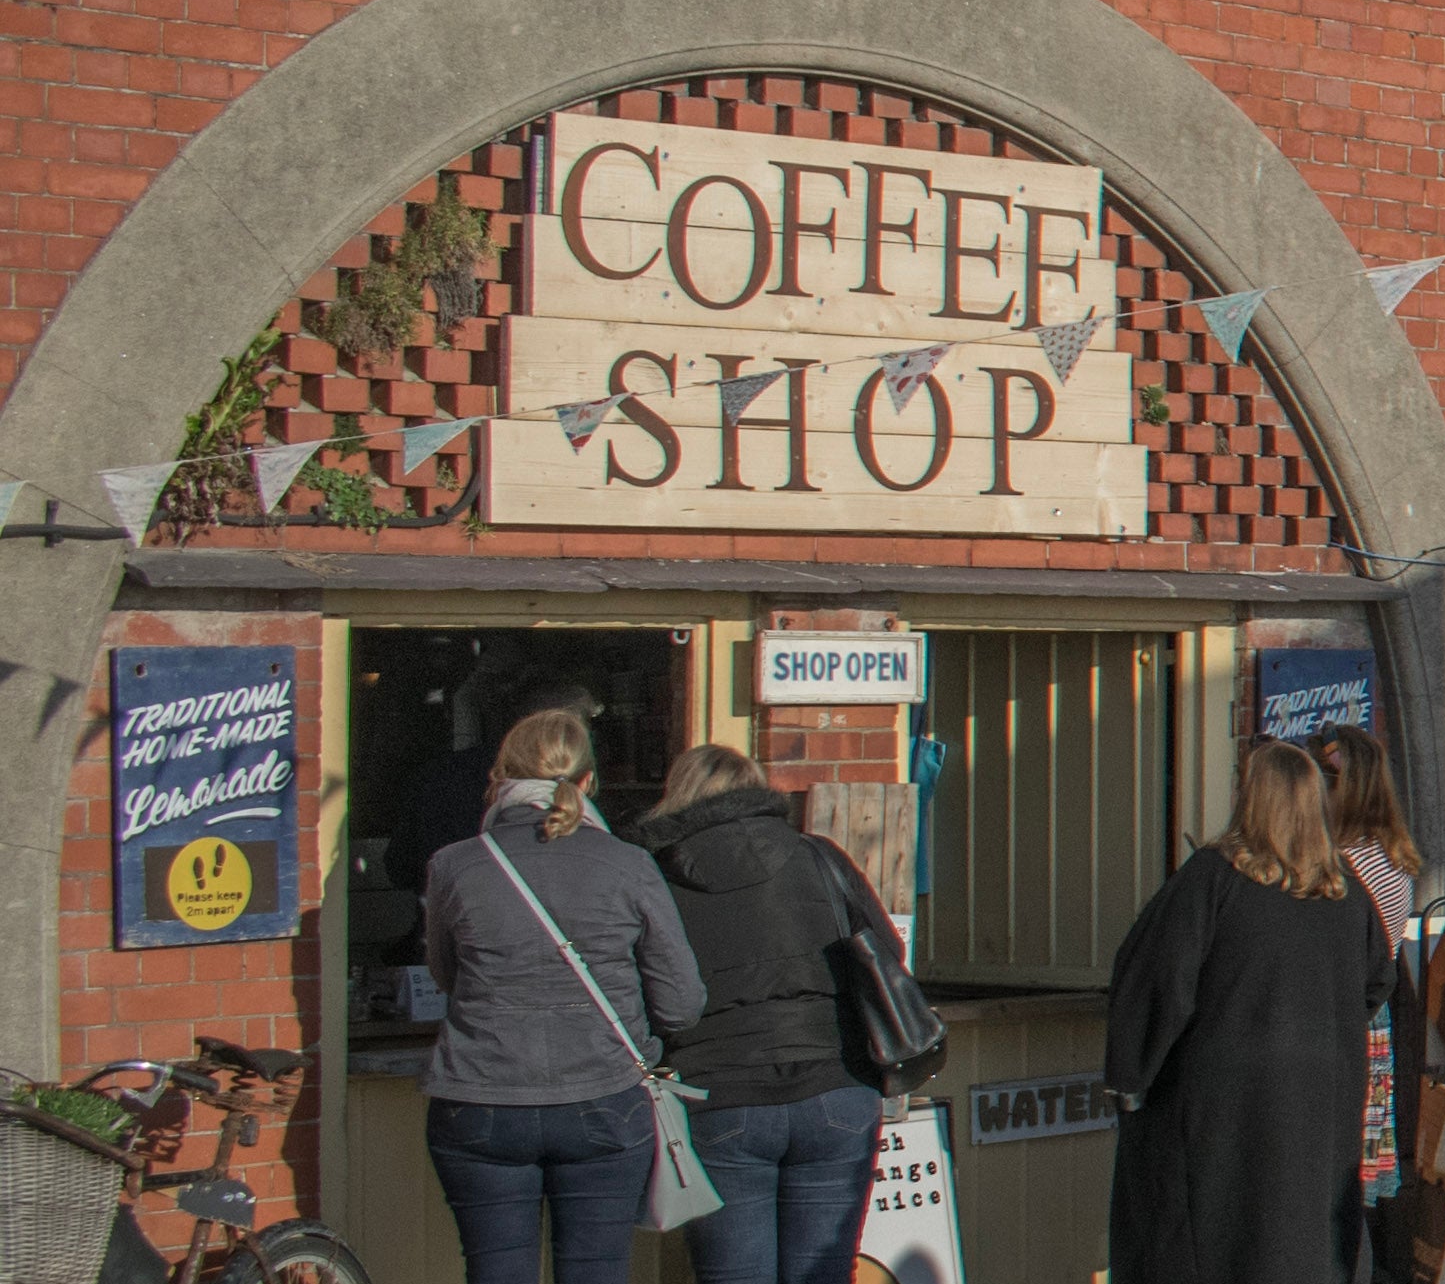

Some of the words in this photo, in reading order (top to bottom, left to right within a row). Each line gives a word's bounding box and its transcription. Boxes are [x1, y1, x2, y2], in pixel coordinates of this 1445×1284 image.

[560, 141, 1097, 333] COFFEE
[605, 348, 1058, 498] SHOP
[773, 652, 841, 682] SHOP
[846, 652, 908, 682] OPEN
[122, 679, 293, 739] TRADITIONAL
[1263, 677, 1370, 718] TRADITIONAL
[121, 709, 294, 770] HOME-MADE
[120, 748, 295, 843] Lemonade
[177, 892, 215, 905] Please
[216, 890, 244, 904] keep
[186, 905, 205, 917] 2m
[206, 903, 236, 919] apart
[875, 1189, 941, 1212] uice
